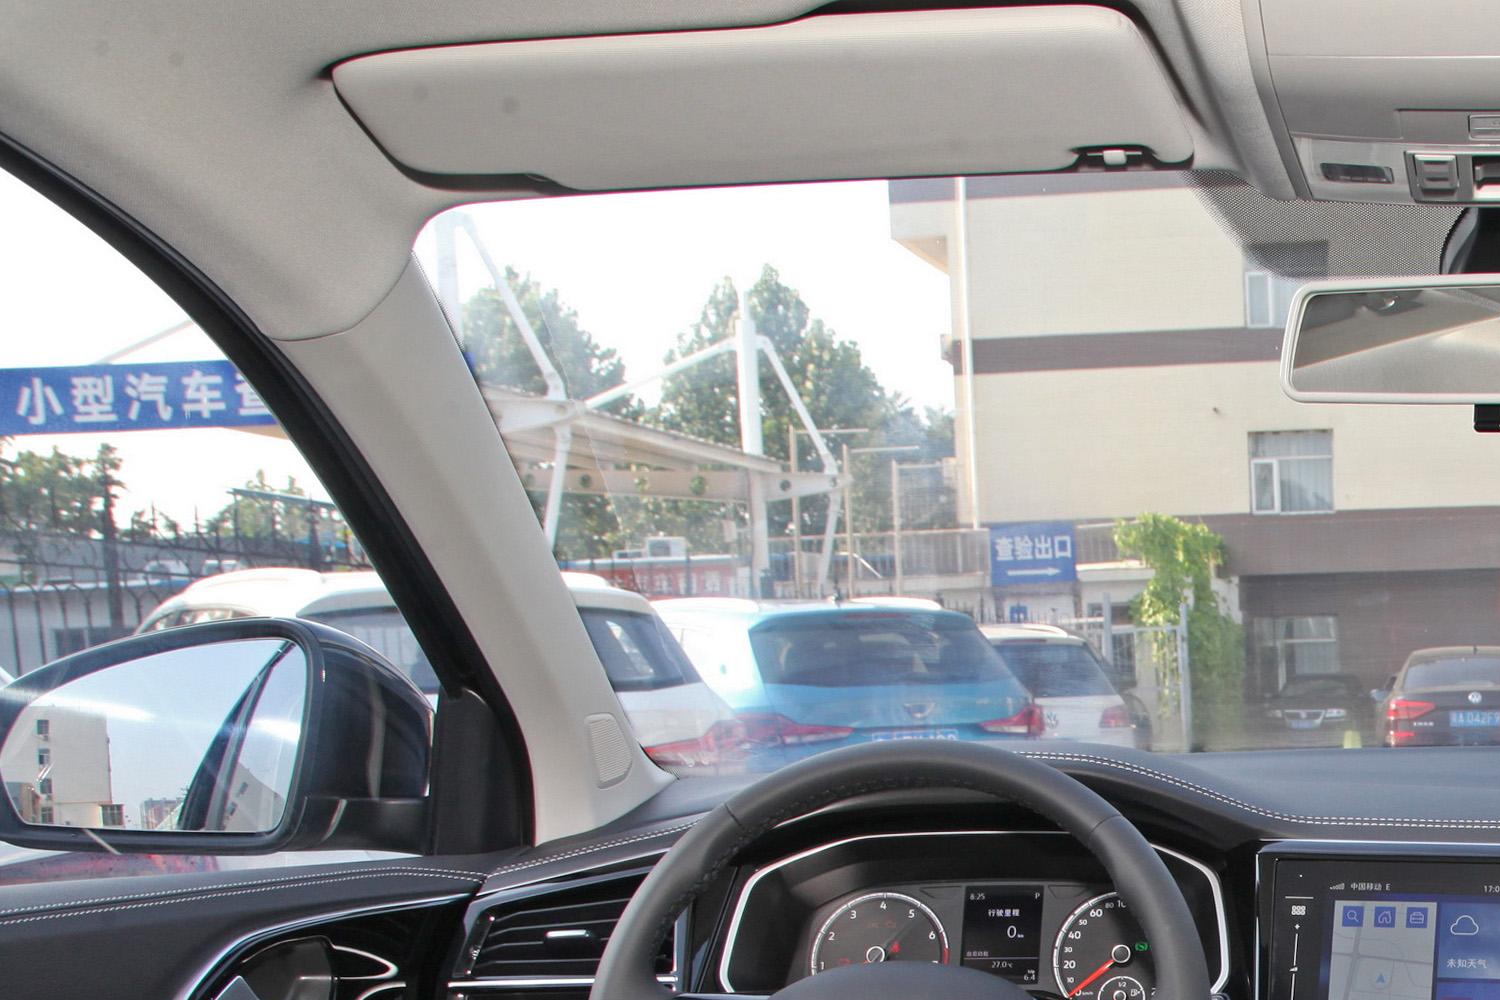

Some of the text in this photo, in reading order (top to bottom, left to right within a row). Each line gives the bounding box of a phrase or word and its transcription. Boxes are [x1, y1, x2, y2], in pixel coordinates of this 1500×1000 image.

[996, 530, 1073, 562] 查验出口
[1350, 882, 1391, 891] 中国移动 E
[879, 901, 887, 910] 4
[850, 910, 857, 919] 3
[908, 910, 915, 918] 5
[987, 908, 1020, 917] 行驶里程
[1089, 908, 1103, 918] 60
[928, 931, 936, 940] 6
[1007, 925, 1017, 938] 0
[1068, 930, 1081, 939] 40
[828, 932, 835, 941] 2
[820, 961, 825, 970] 1
[1063, 960, 1076, 969] 20
[1446, 958, 1488, 969] 未知天气
